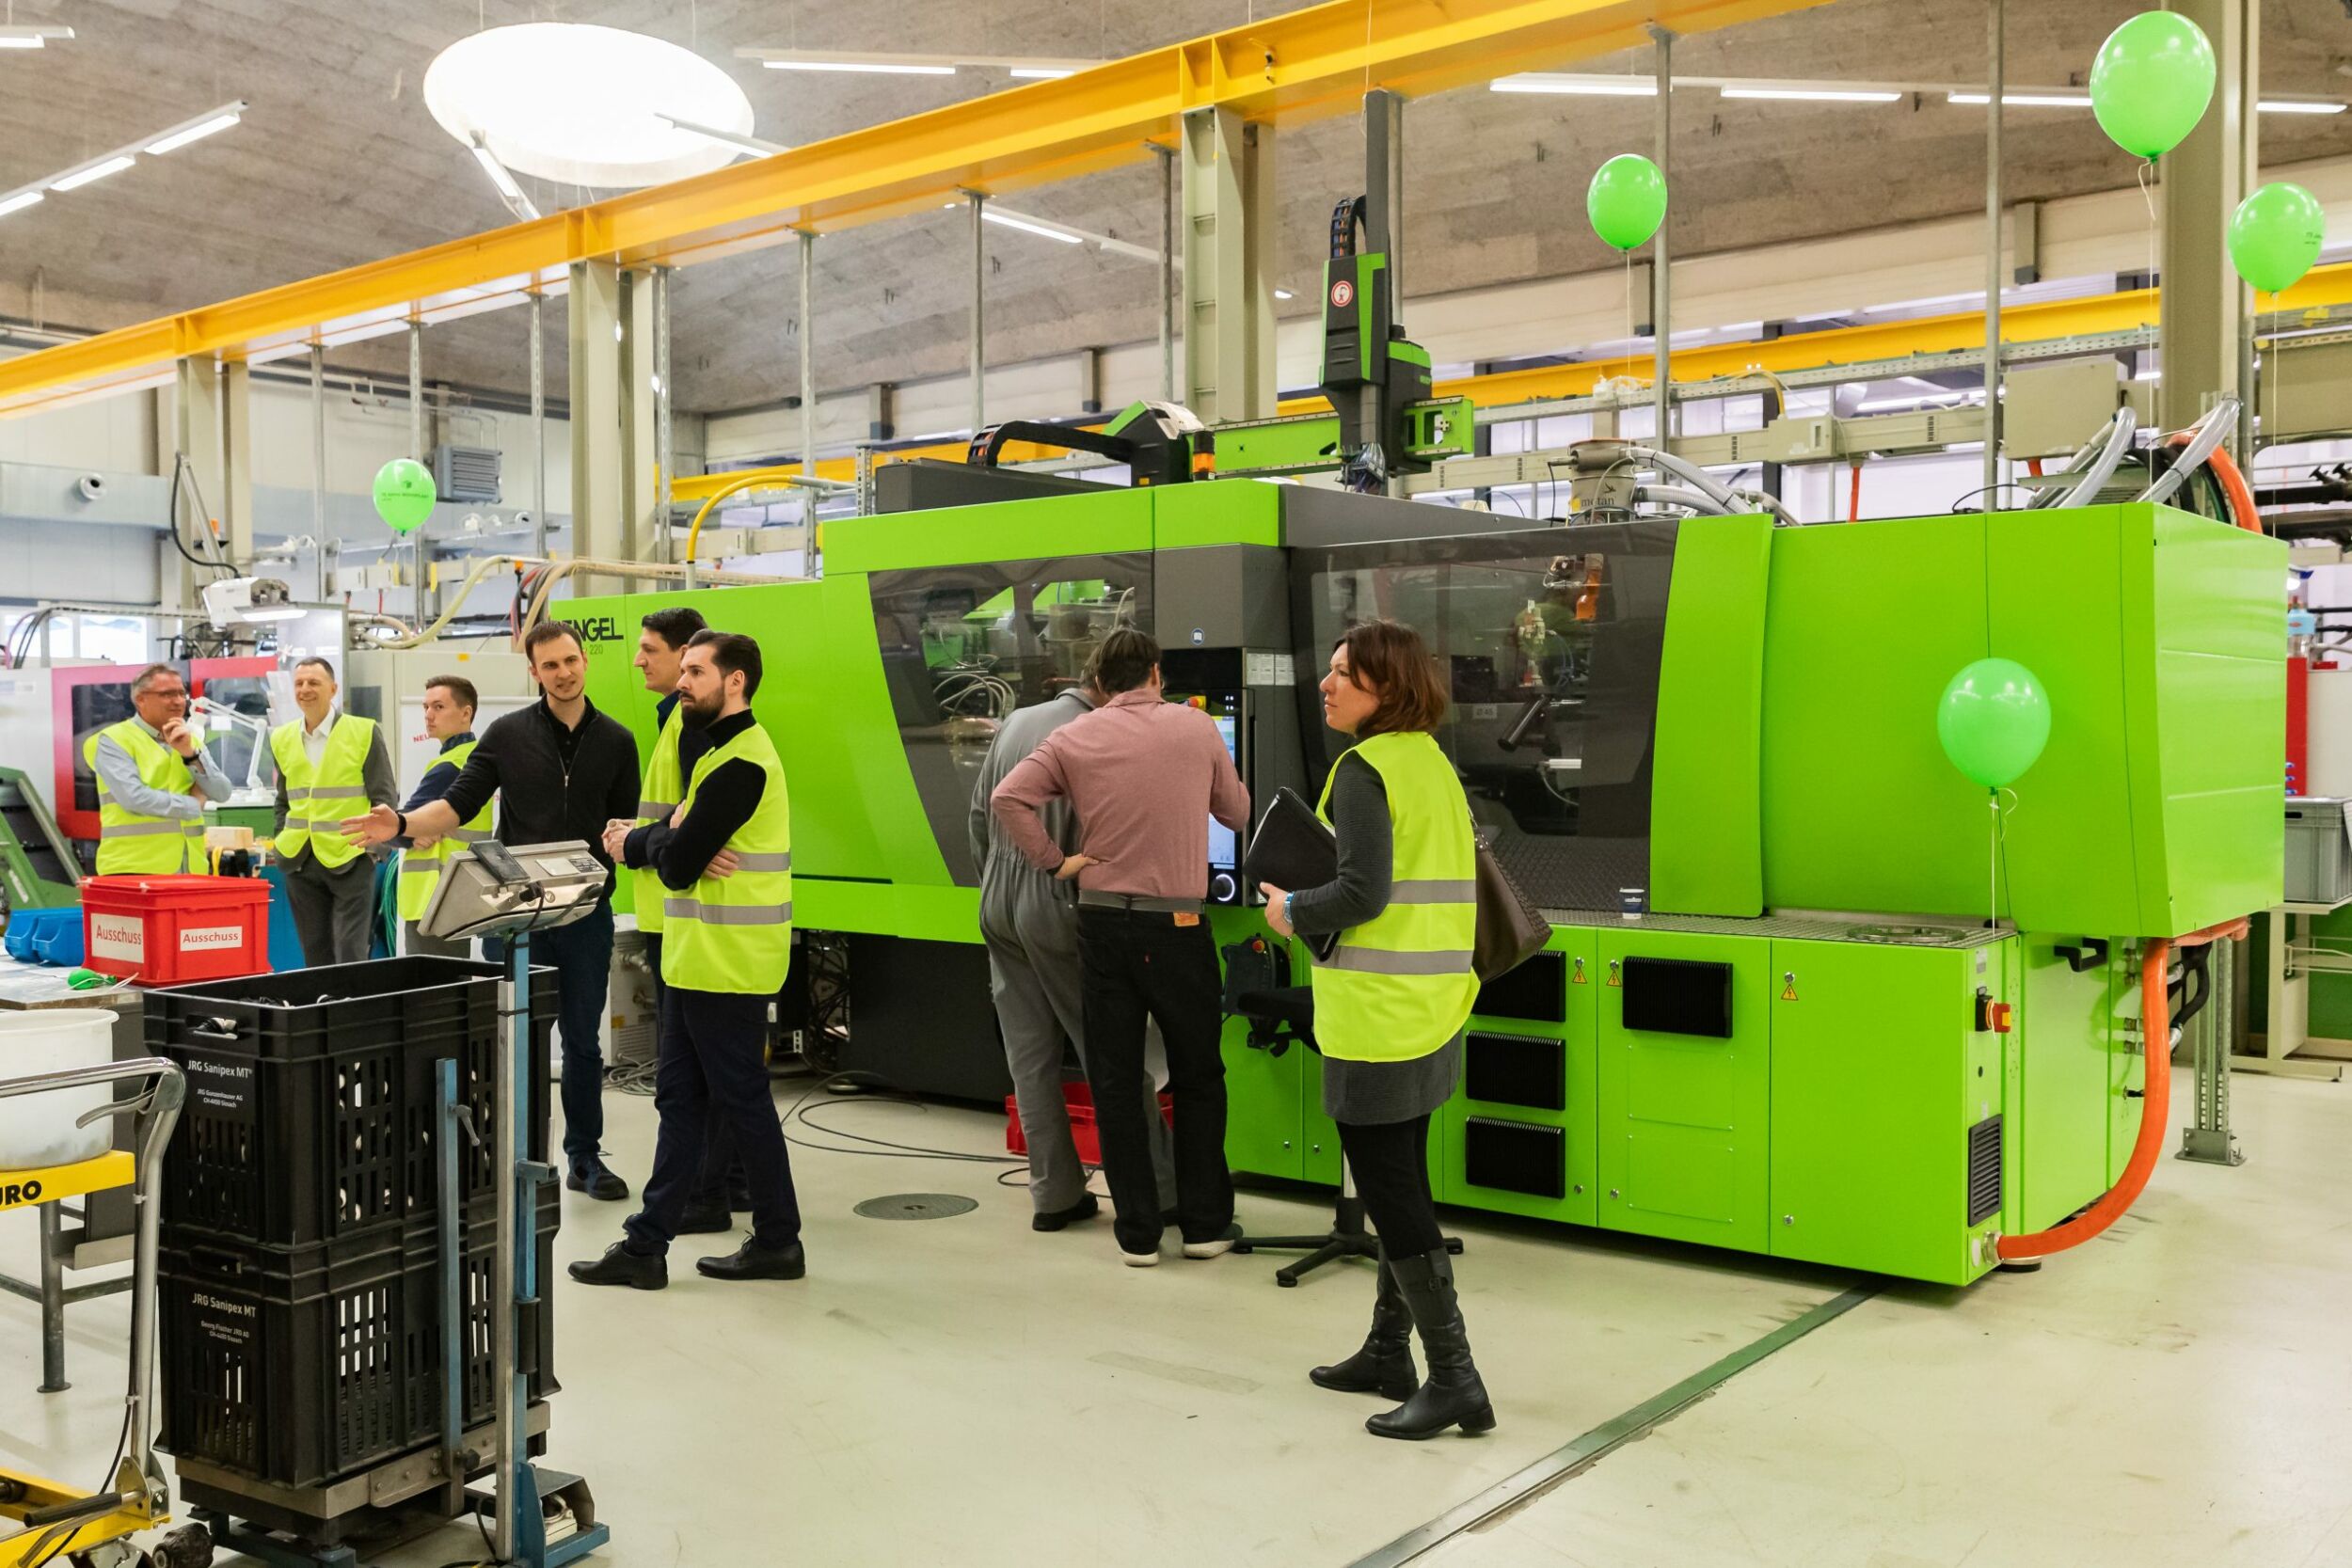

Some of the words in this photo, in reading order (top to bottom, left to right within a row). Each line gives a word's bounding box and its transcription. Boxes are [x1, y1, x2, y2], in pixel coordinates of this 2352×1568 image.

[563, 617, 624, 641] NGEL
[96, 925, 142, 945] Ausschuss
[183, 931, 239, 943] Ausschuss
[188, 1060, 202, 1071] JRG
[204, 1062, 235, 1078] Sanipex
[0, 1180, 42, 1205] RO
[192, 1292, 209, 1307] JRG
[211, 1297, 243, 1314] Sanipex
[245, 1305, 256, 1317] MT
